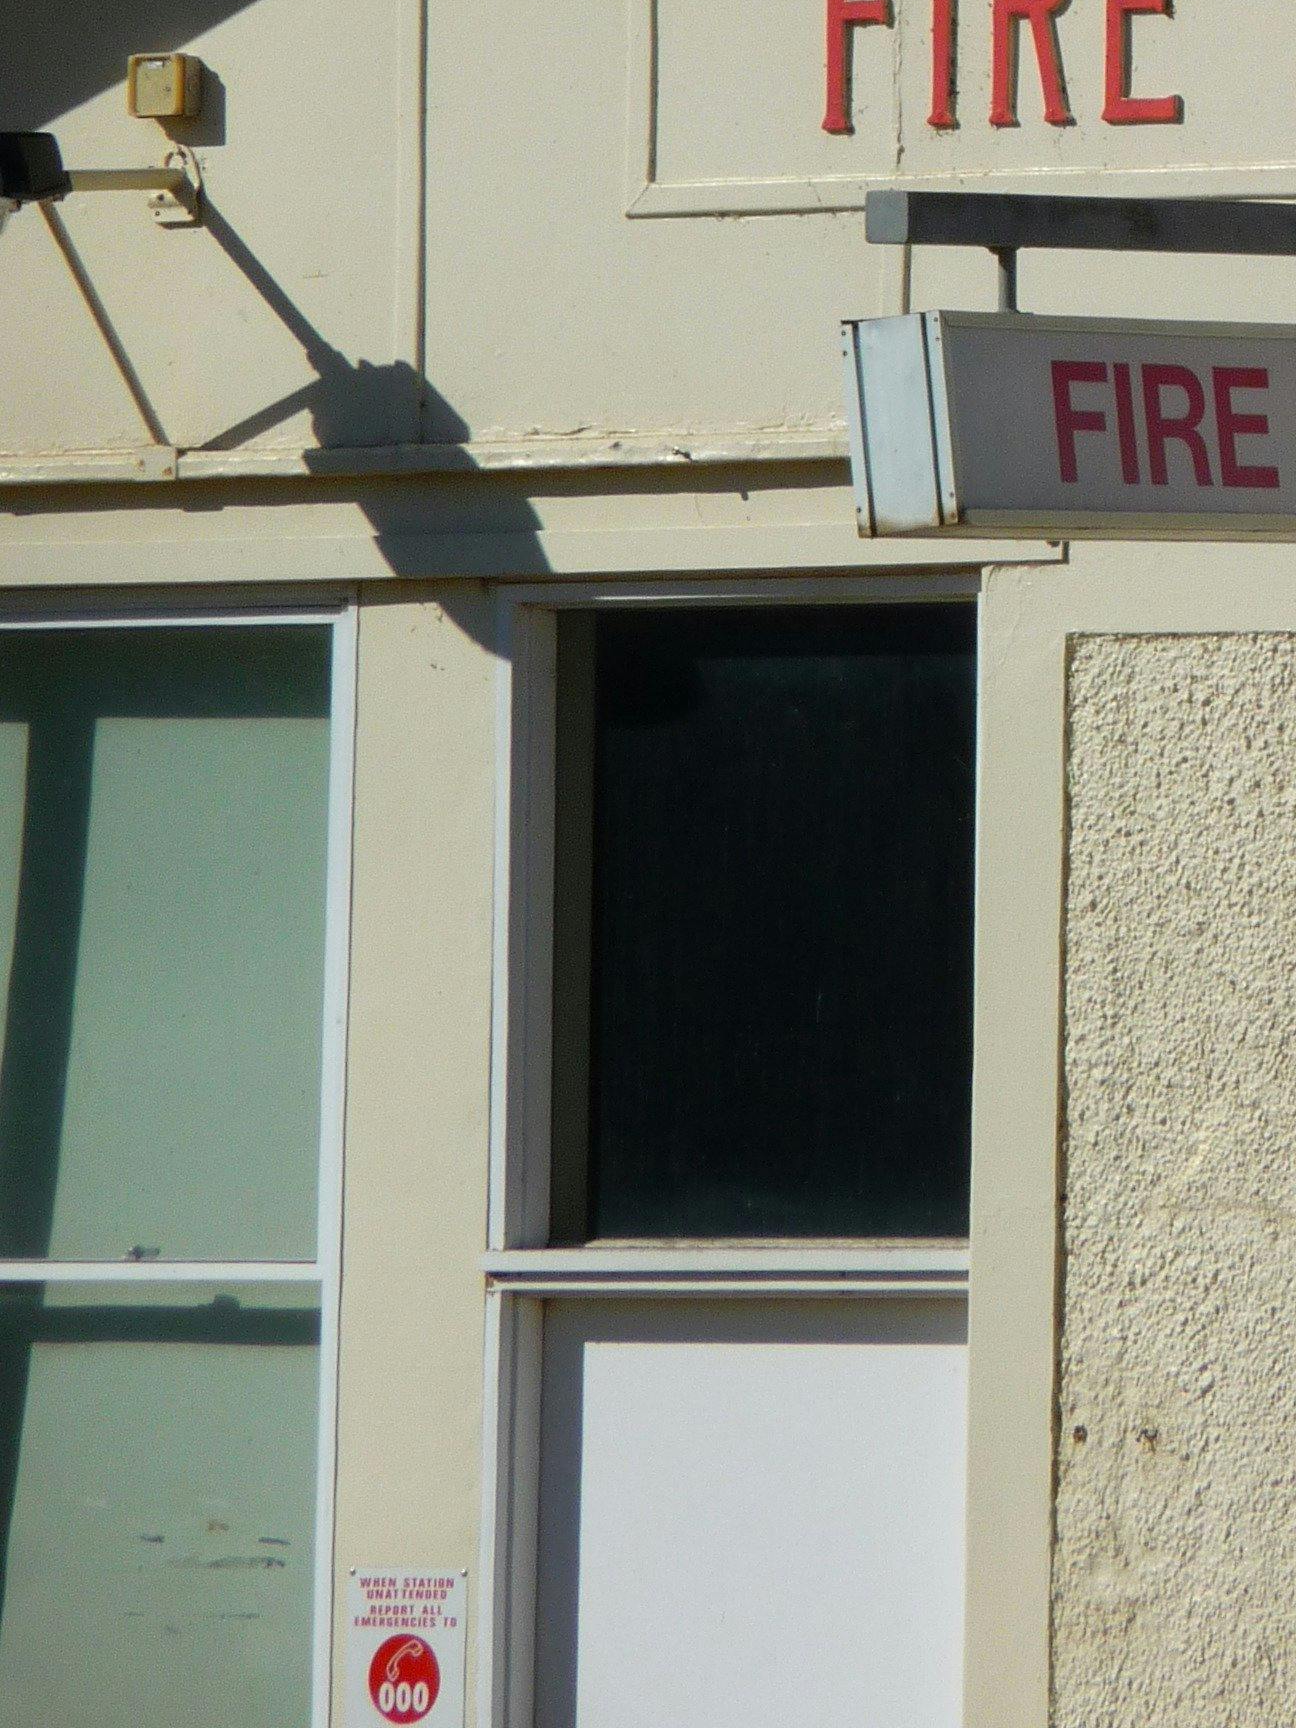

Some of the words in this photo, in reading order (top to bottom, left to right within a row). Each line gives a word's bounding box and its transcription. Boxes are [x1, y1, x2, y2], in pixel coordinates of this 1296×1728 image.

[1050, 359, 1280, 488] FIRE
[360, 1577, 397, 1588] WHEN
[404, 1577, 455, 1588] STATION
[366, 1589, 447, 1600] UNATTENDED
[370, 1604, 415, 1615] REPORT
[422, 1604, 442, 1615] ALL
[354, 1616, 436, 1627] EMERGENCIES
[444, 1616, 457, 1627] TO
[379, 1681, 429, 1713] 000
